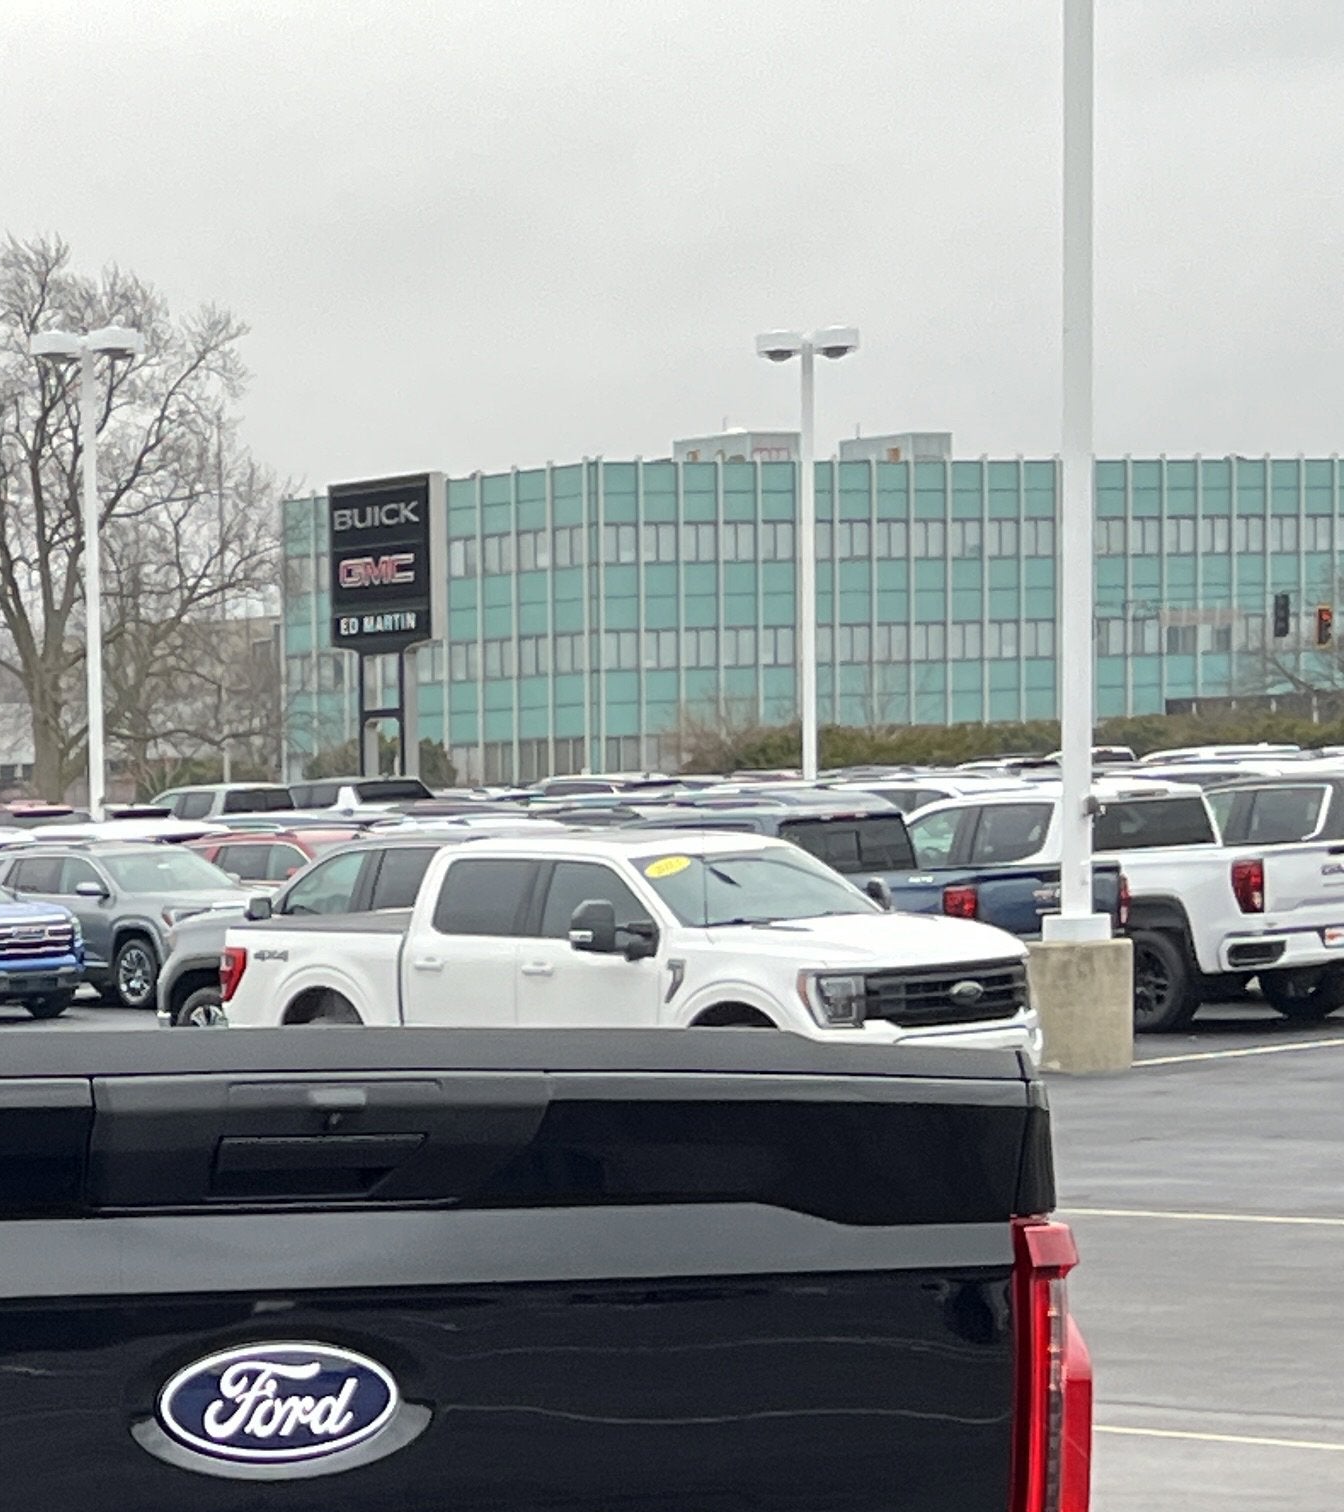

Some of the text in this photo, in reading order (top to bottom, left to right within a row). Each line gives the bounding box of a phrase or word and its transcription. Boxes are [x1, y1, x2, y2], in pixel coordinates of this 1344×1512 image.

[333, 500, 420, 531] BUICK
[338, 552, 415, 588] GMC
[339, 612, 417, 635] ED MARTIN
[203, 1361, 359, 1439] Ford
